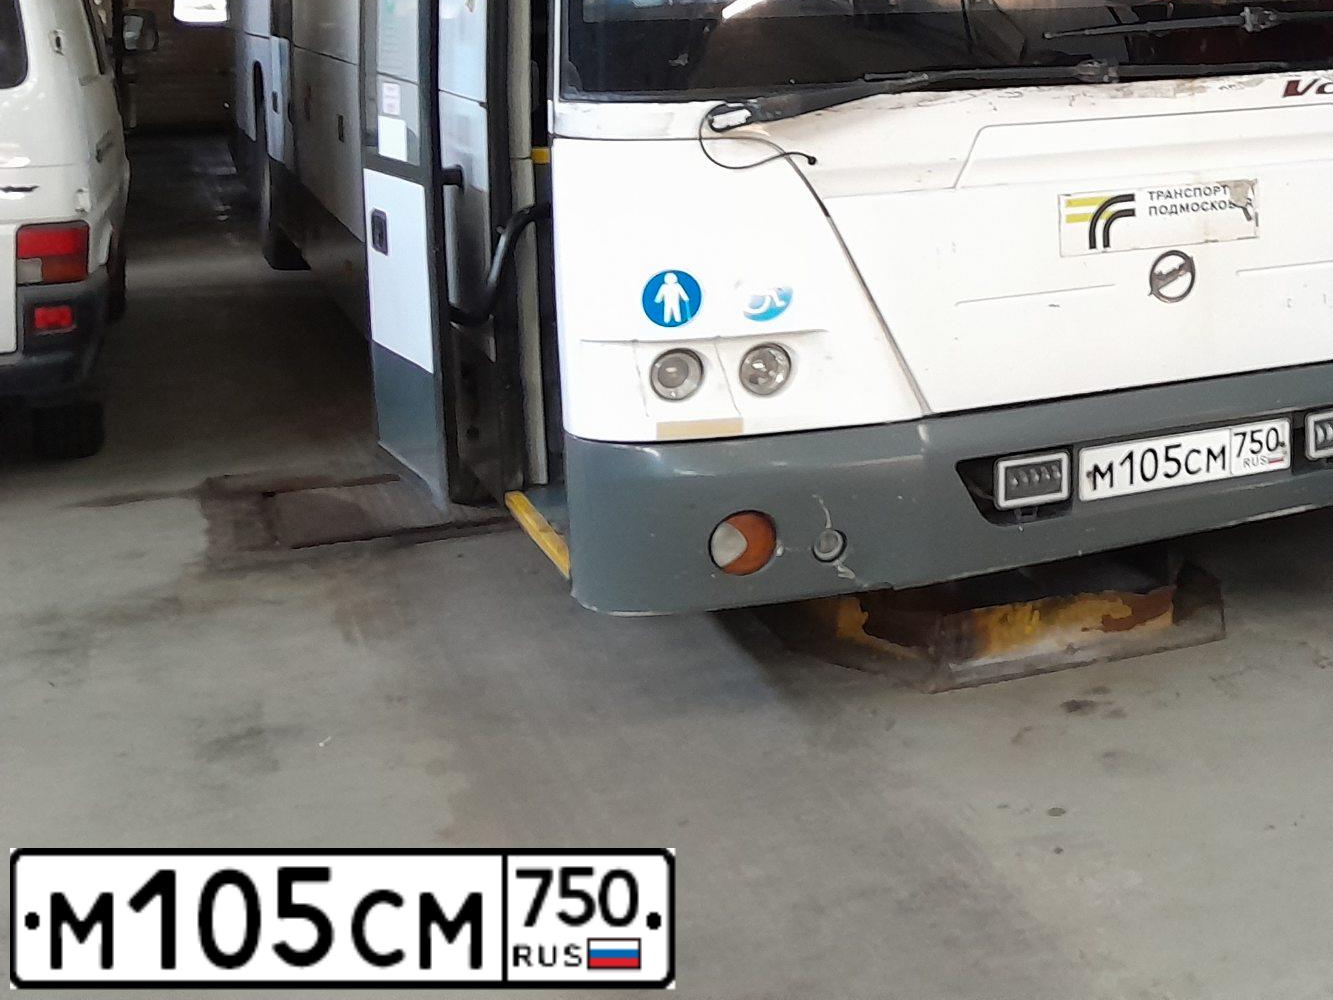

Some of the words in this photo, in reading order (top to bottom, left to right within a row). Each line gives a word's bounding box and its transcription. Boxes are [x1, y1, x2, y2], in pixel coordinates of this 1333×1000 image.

[1147, 184, 1229, 201] ТРАНСПОРТ
[1092, 443, 1226, 491] М105СМ
[1233, 427, 1280, 458] 750
[1243, 456, 1266, 468] RUS
